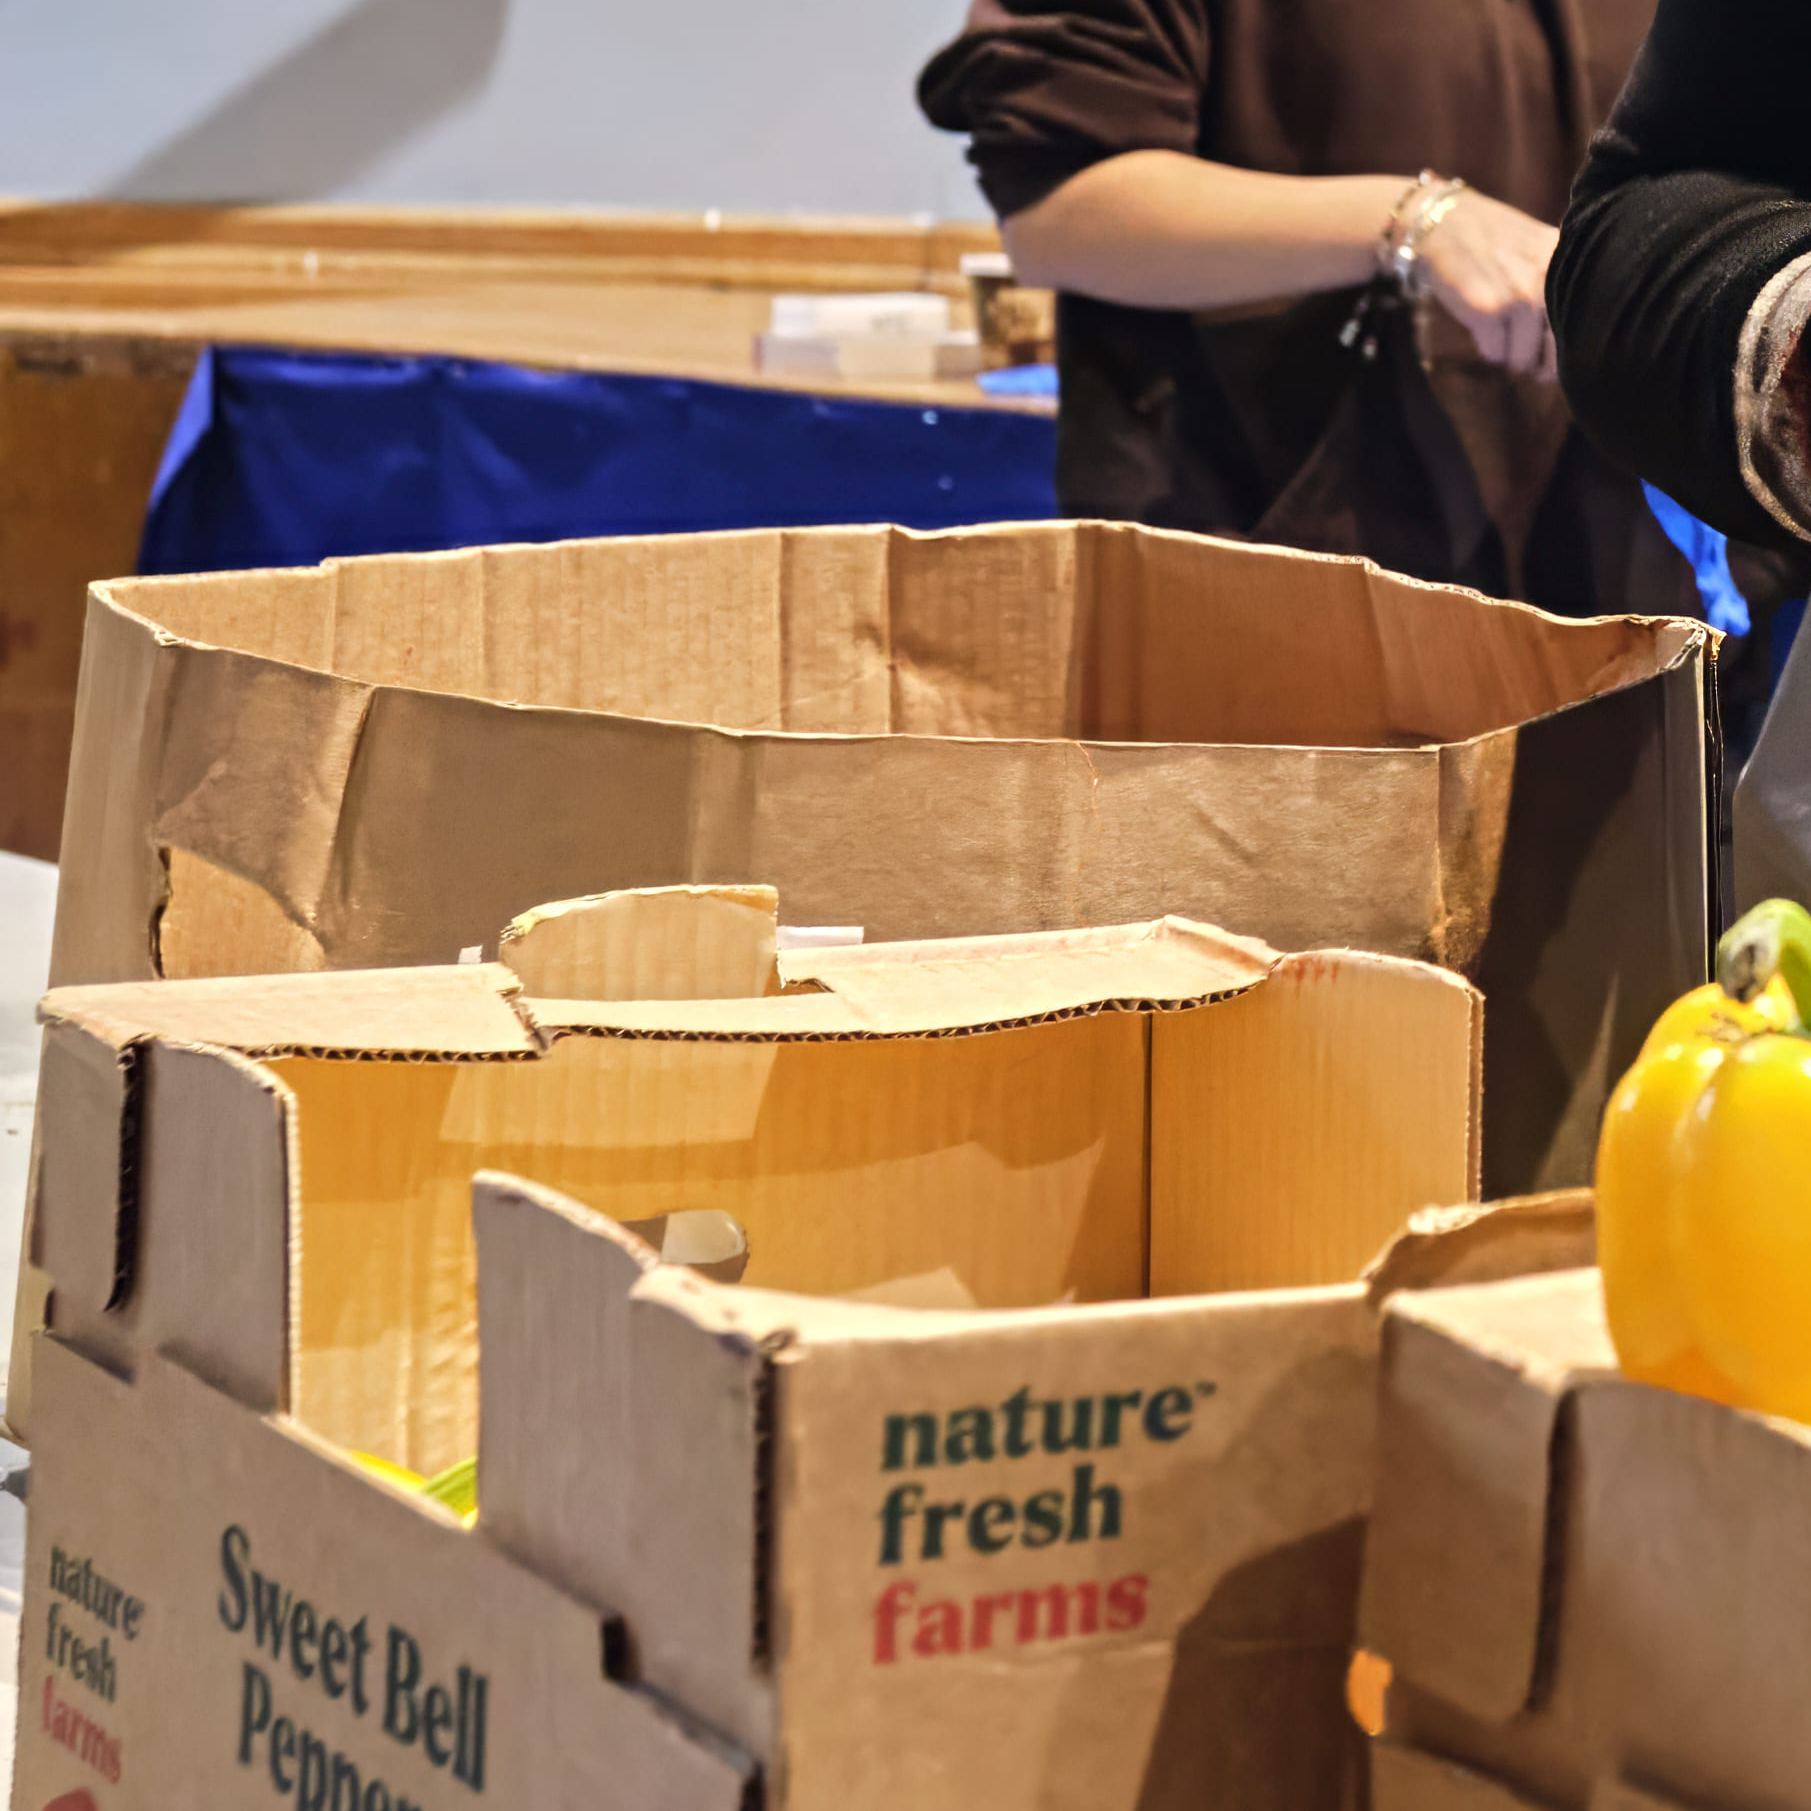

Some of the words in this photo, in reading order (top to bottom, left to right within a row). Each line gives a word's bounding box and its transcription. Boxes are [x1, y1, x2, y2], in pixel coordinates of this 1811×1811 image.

[880, 1382, 1196, 1473] nature
[877, 1463, 1124, 1567] fresh
[49, 1543, 146, 1643] nature
[873, 1572, 1151, 1666] farms
[45, 1601, 117, 1704] fresh
[218, 1524, 374, 1719] Sweet
[382, 1623, 489, 1793] Bell
[40, 1673, 122, 1785] farms
